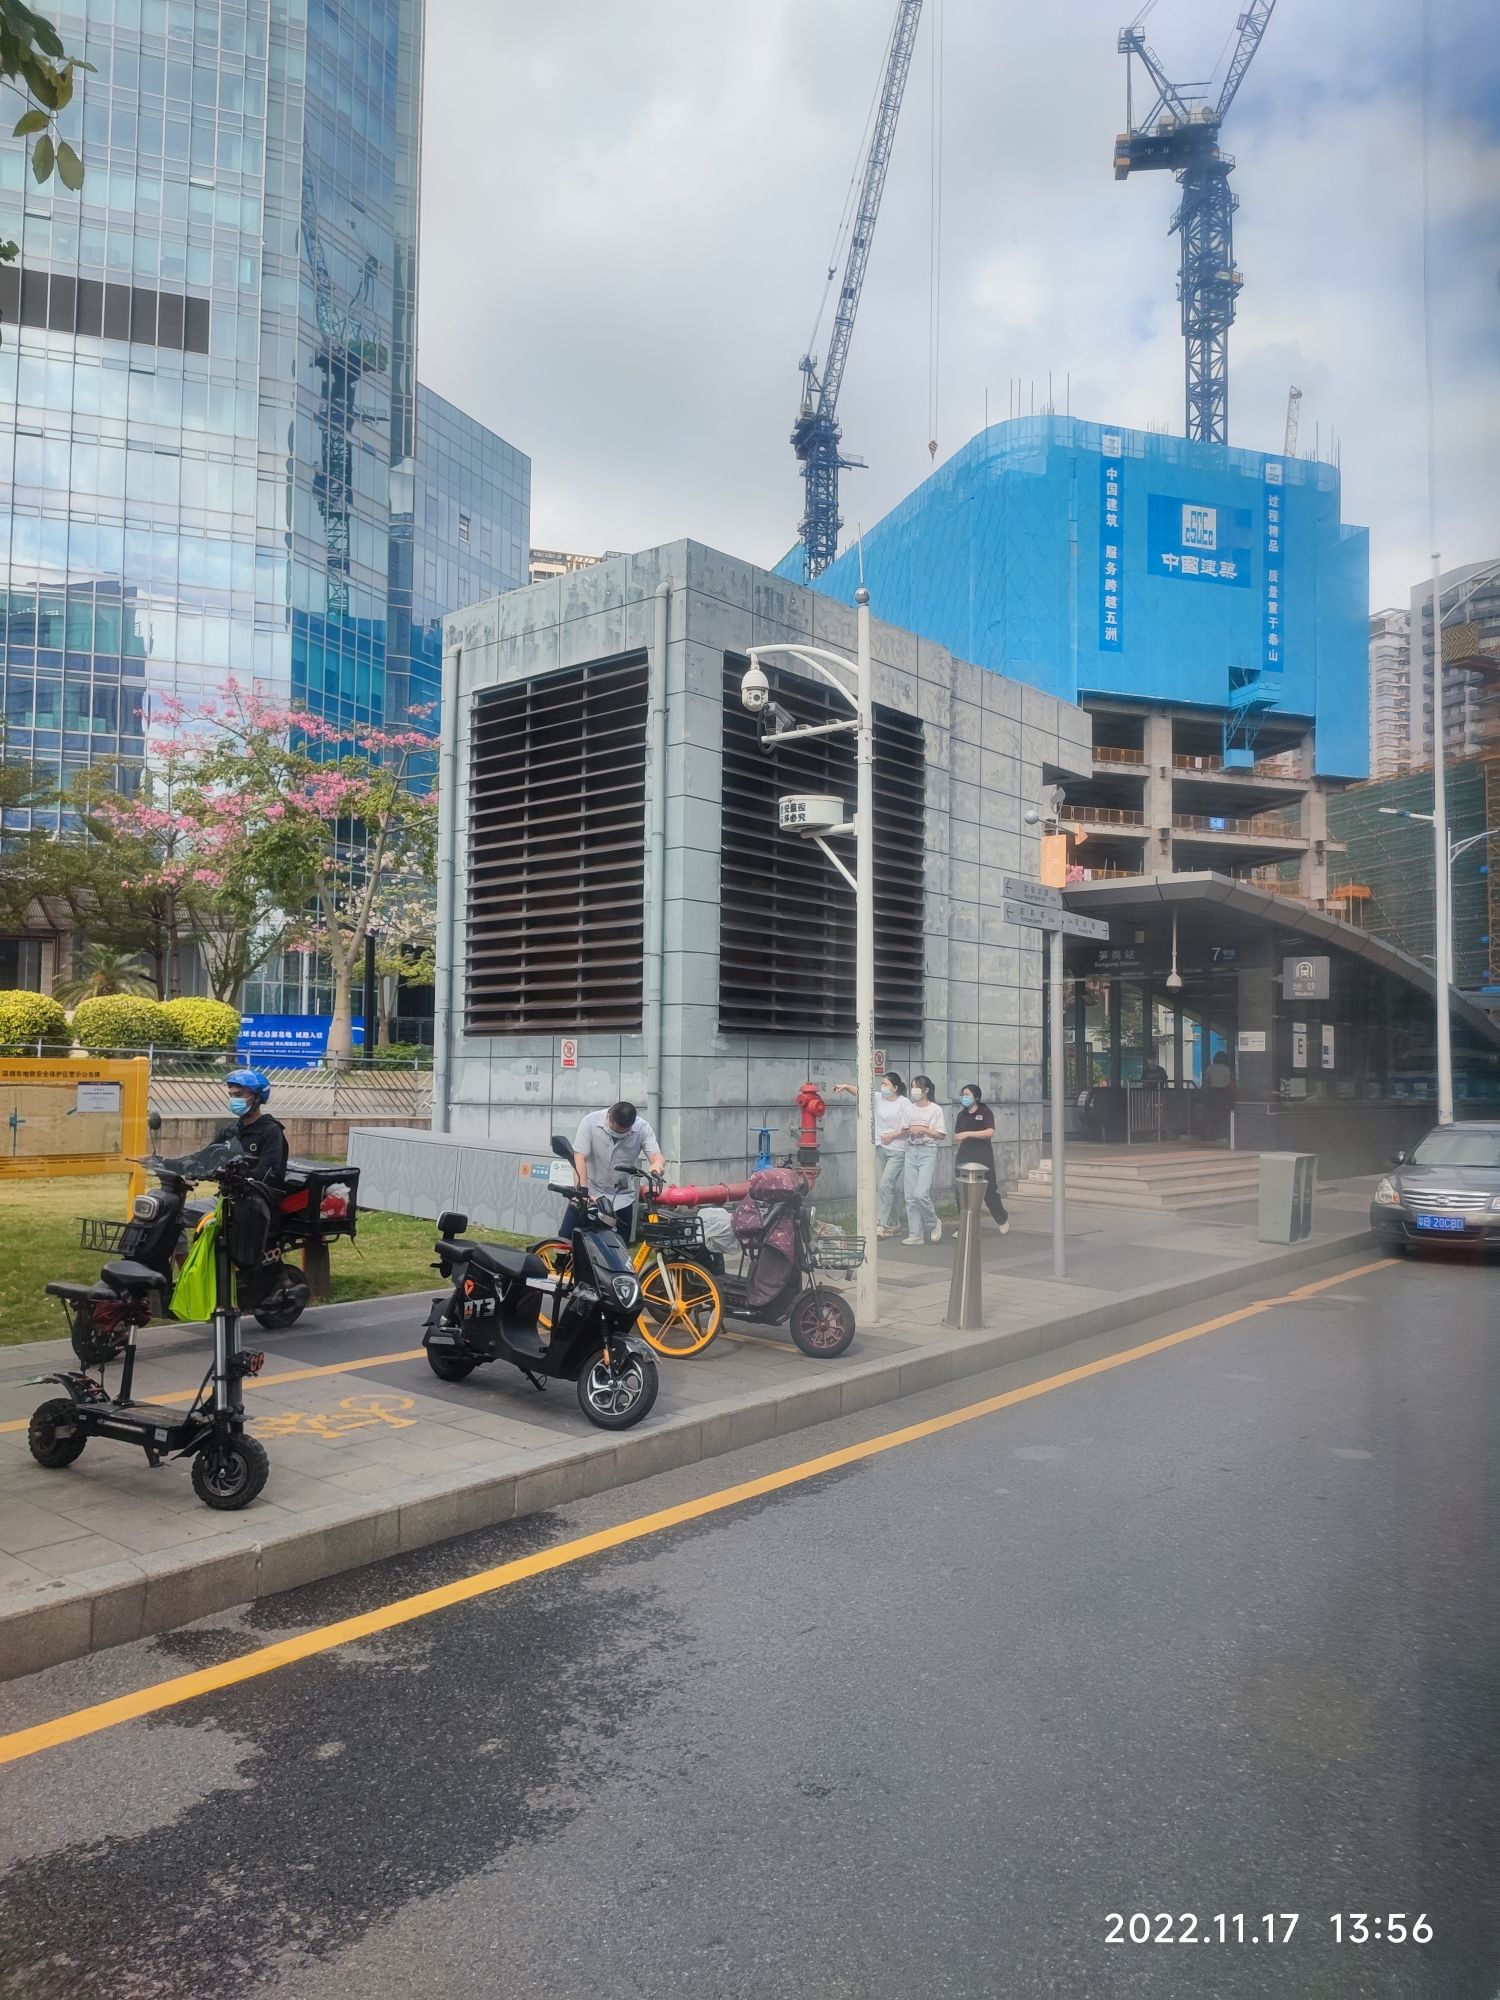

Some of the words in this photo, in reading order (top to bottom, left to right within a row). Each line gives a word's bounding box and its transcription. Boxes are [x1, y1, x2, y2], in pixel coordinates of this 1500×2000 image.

[1106, 467, 1119, 528] 中国建筑
[1211, 947, 1221, 962] 7
[1298, 1038, 1303, 1055] E
